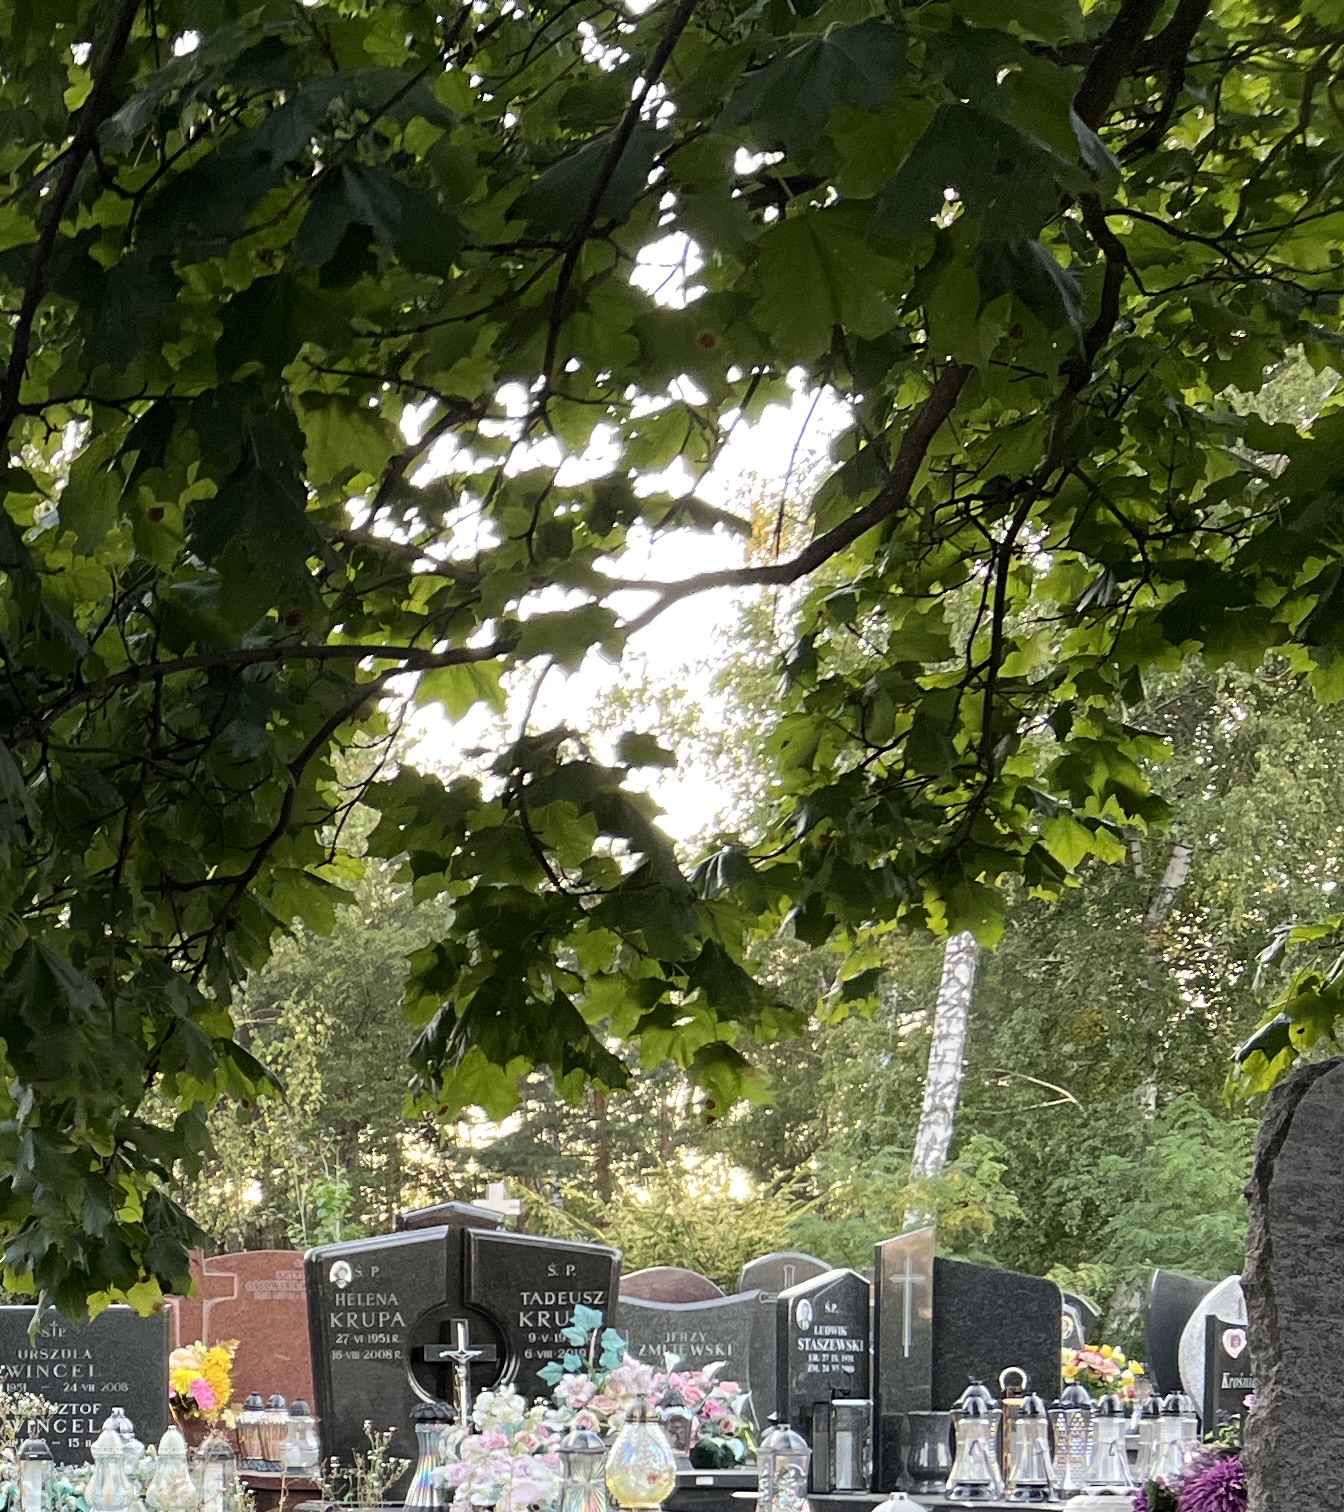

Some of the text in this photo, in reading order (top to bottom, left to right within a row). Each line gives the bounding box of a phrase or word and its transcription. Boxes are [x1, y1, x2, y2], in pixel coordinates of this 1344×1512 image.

[335, 1293, 399, 1307] HELENA
[519, 1291, 605, 1306] TADEUSZ
[329, 1312, 406, 1329] KRUPA
[518, 1310, 570, 1329] KRU
[813, 1325, 849, 1336] LUDWIK
[797, 1337, 864, 1352] STASZEWSKI
[17, 1348, 93, 1360] URSZULA
